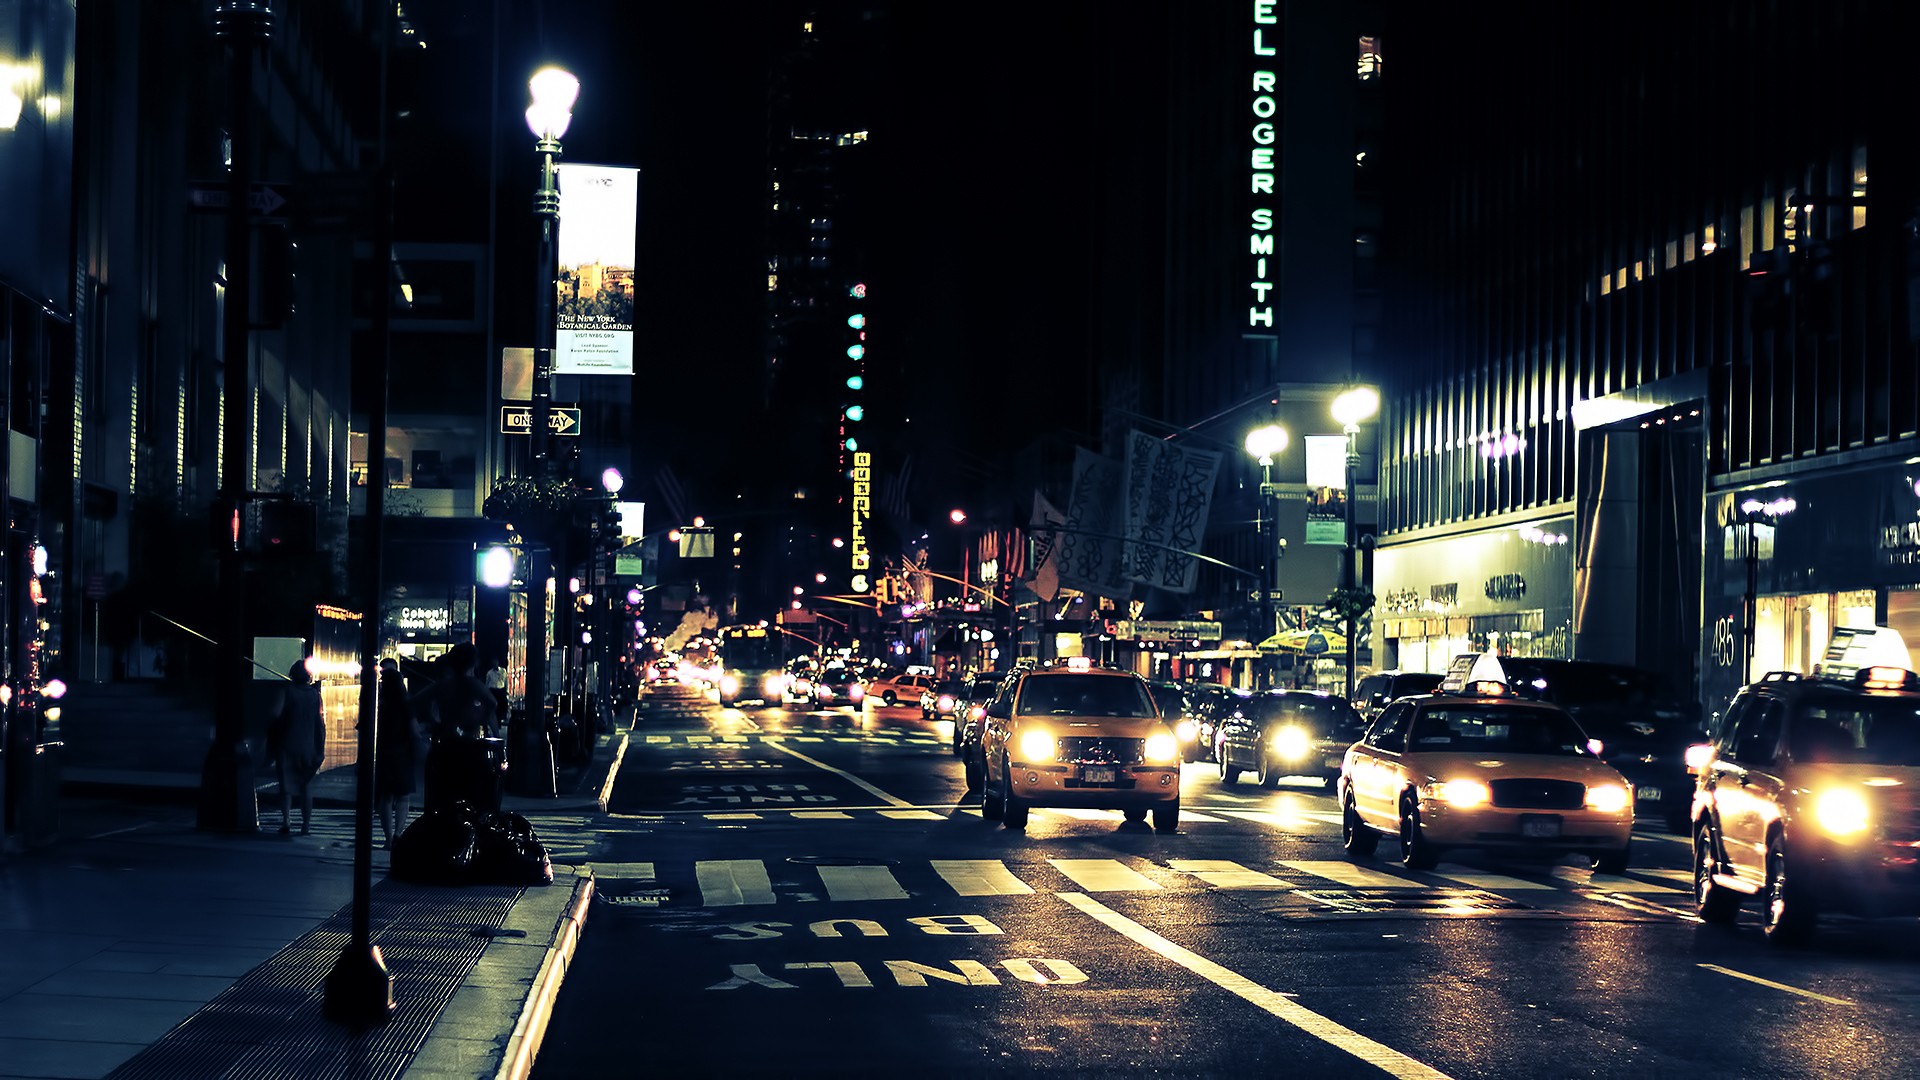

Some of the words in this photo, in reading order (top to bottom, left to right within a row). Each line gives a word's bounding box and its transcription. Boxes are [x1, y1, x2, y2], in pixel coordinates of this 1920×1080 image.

[1251, 70, 1276, 194] ROGER
[1249, 208, 1274, 328] SMITH
[559, 321, 601, 330] BOTANICAL
[601, 322, 632, 330] GARDEN
[577, 314, 596, 322] NEW
[596, 314, 616, 323] YORK
[1711, 617, 1735, 667] 485
[713, 914, 1006, 940] BUS
[705, 957, 1090, 990] ONLY
